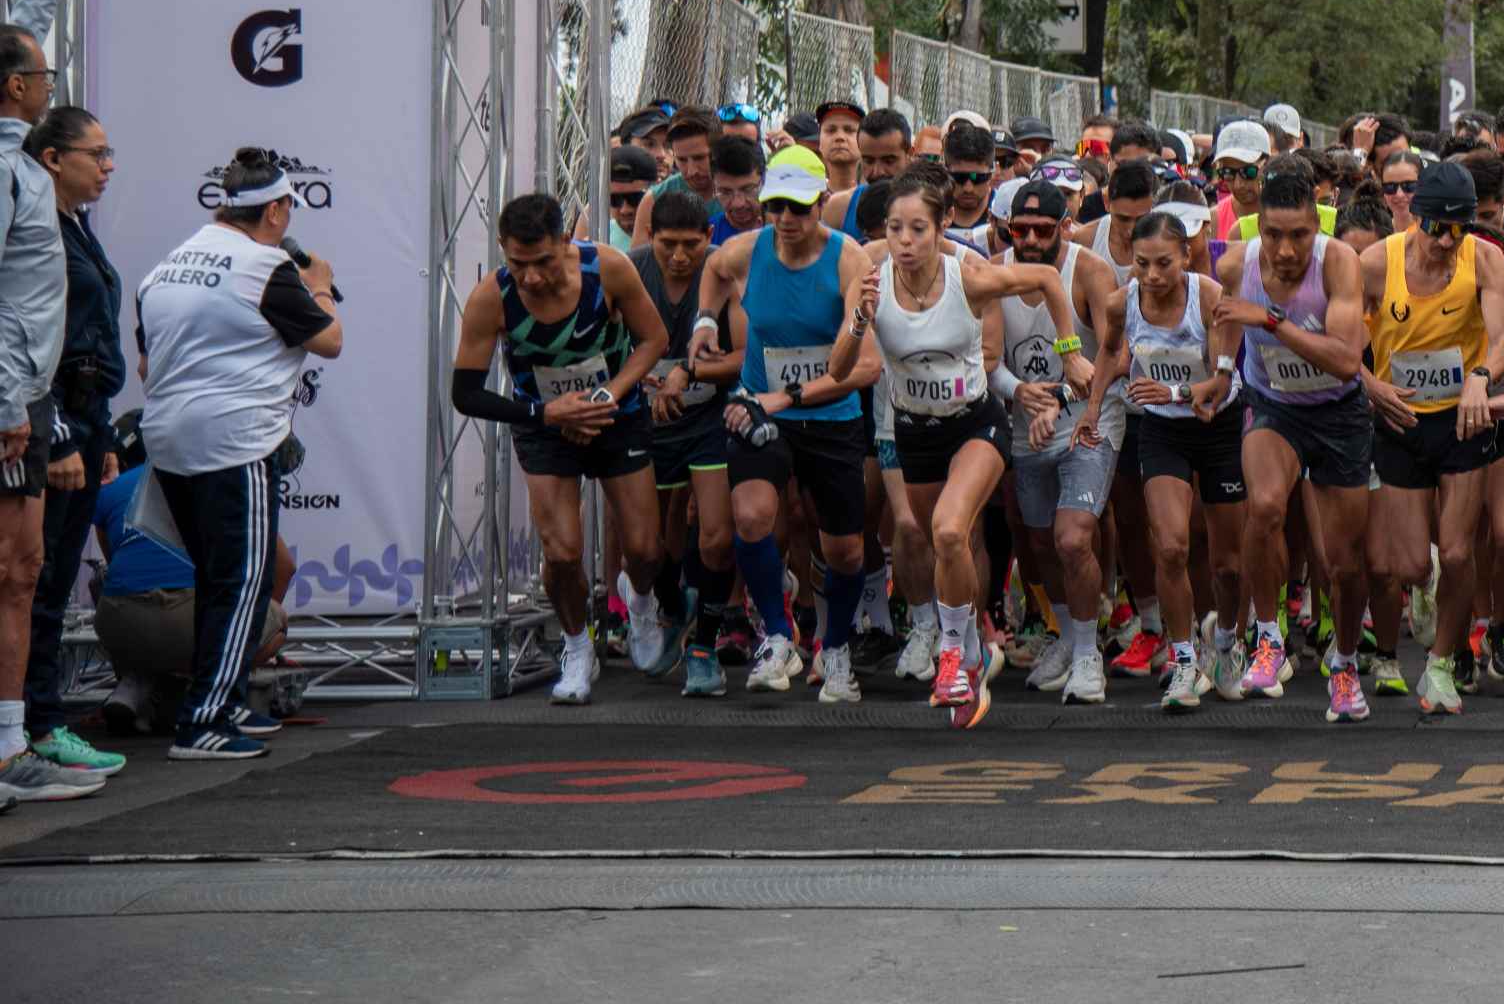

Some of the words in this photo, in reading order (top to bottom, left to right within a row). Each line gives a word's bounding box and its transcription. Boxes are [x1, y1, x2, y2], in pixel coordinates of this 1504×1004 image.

[171, 251, 233, 271] ARTHA
[1150, 363, 1191, 382] 0009
[1406, 368, 1450, 388] 2948
[906, 378, 952, 400] 0705
